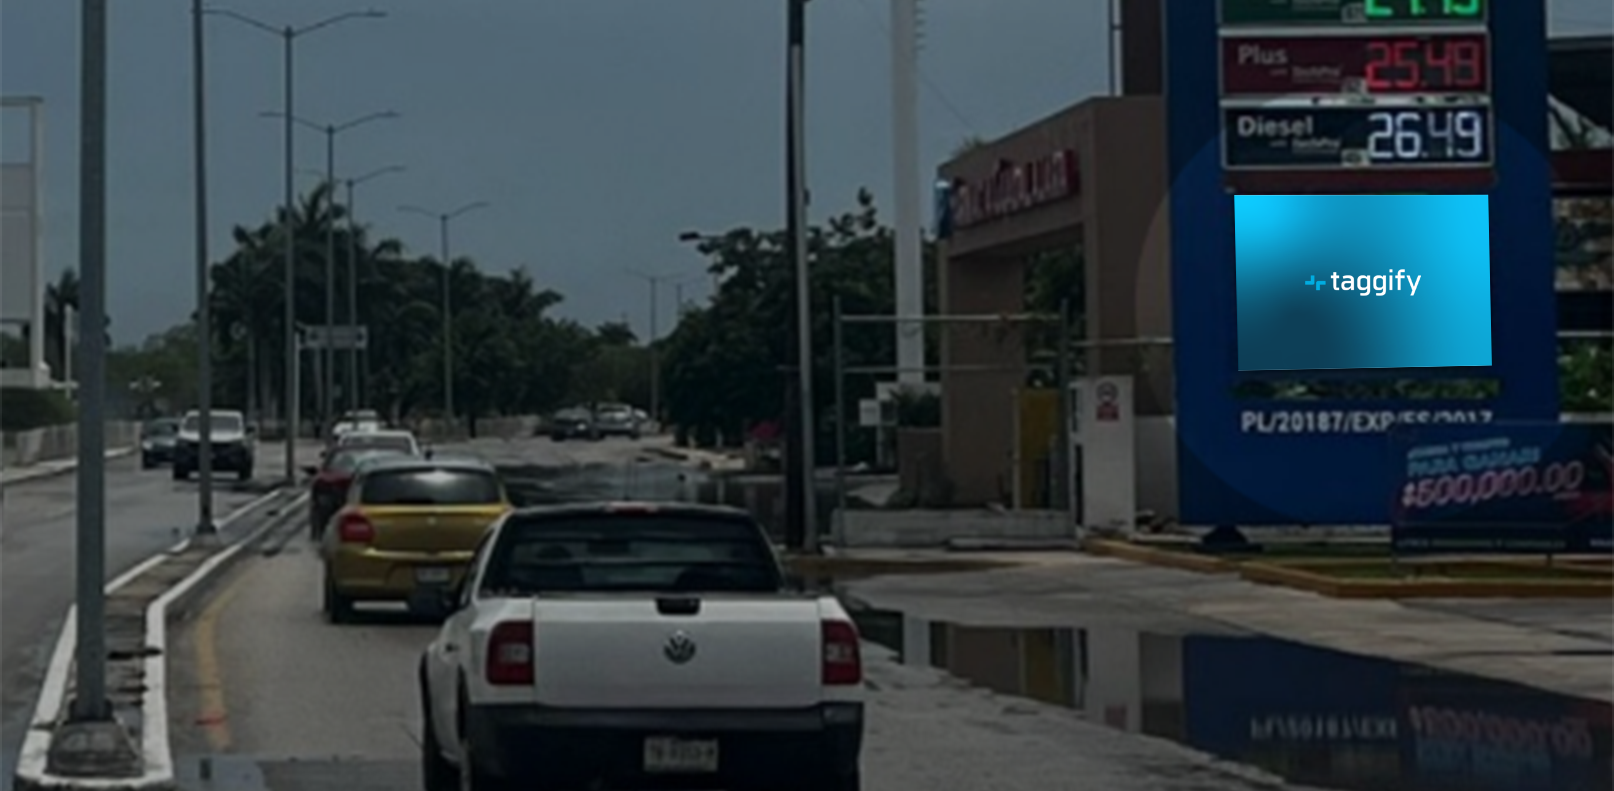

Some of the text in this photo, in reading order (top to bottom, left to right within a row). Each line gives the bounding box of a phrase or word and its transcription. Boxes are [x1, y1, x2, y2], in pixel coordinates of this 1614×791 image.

[1237, 44, 1288, 65] Plus
[1366, 42, 1481, 88] 25.49
[1237, 115, 1314, 138] Diesel
[1367, 112, 1482, 159] 26.49
